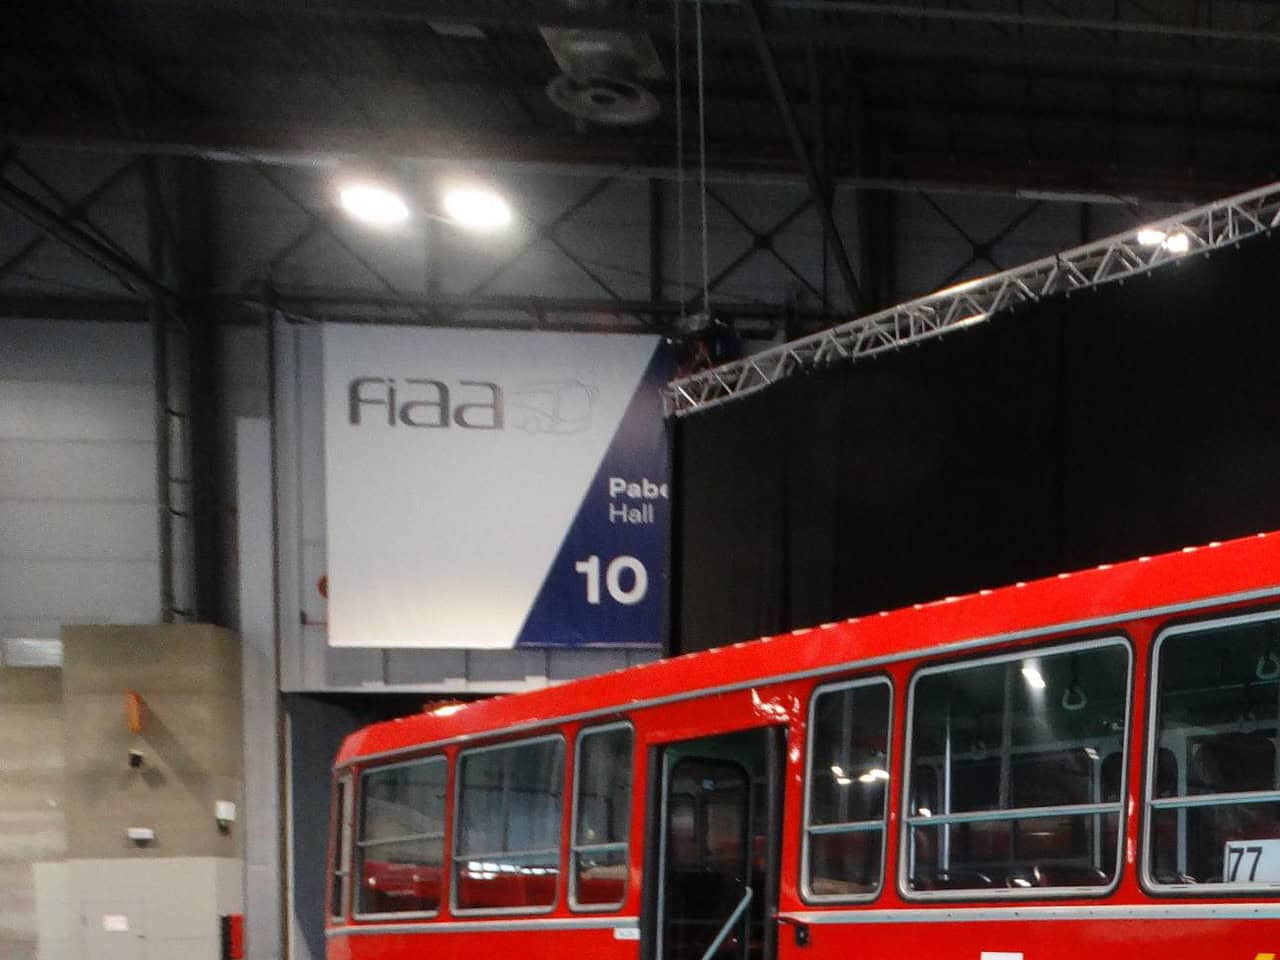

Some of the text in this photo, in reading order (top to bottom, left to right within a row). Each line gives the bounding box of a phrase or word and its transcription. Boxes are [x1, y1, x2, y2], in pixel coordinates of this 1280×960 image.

[609, 503, 653, 523] Hall
[575, 554, 648, 605] 10
[1229, 846, 1263, 883] 77
